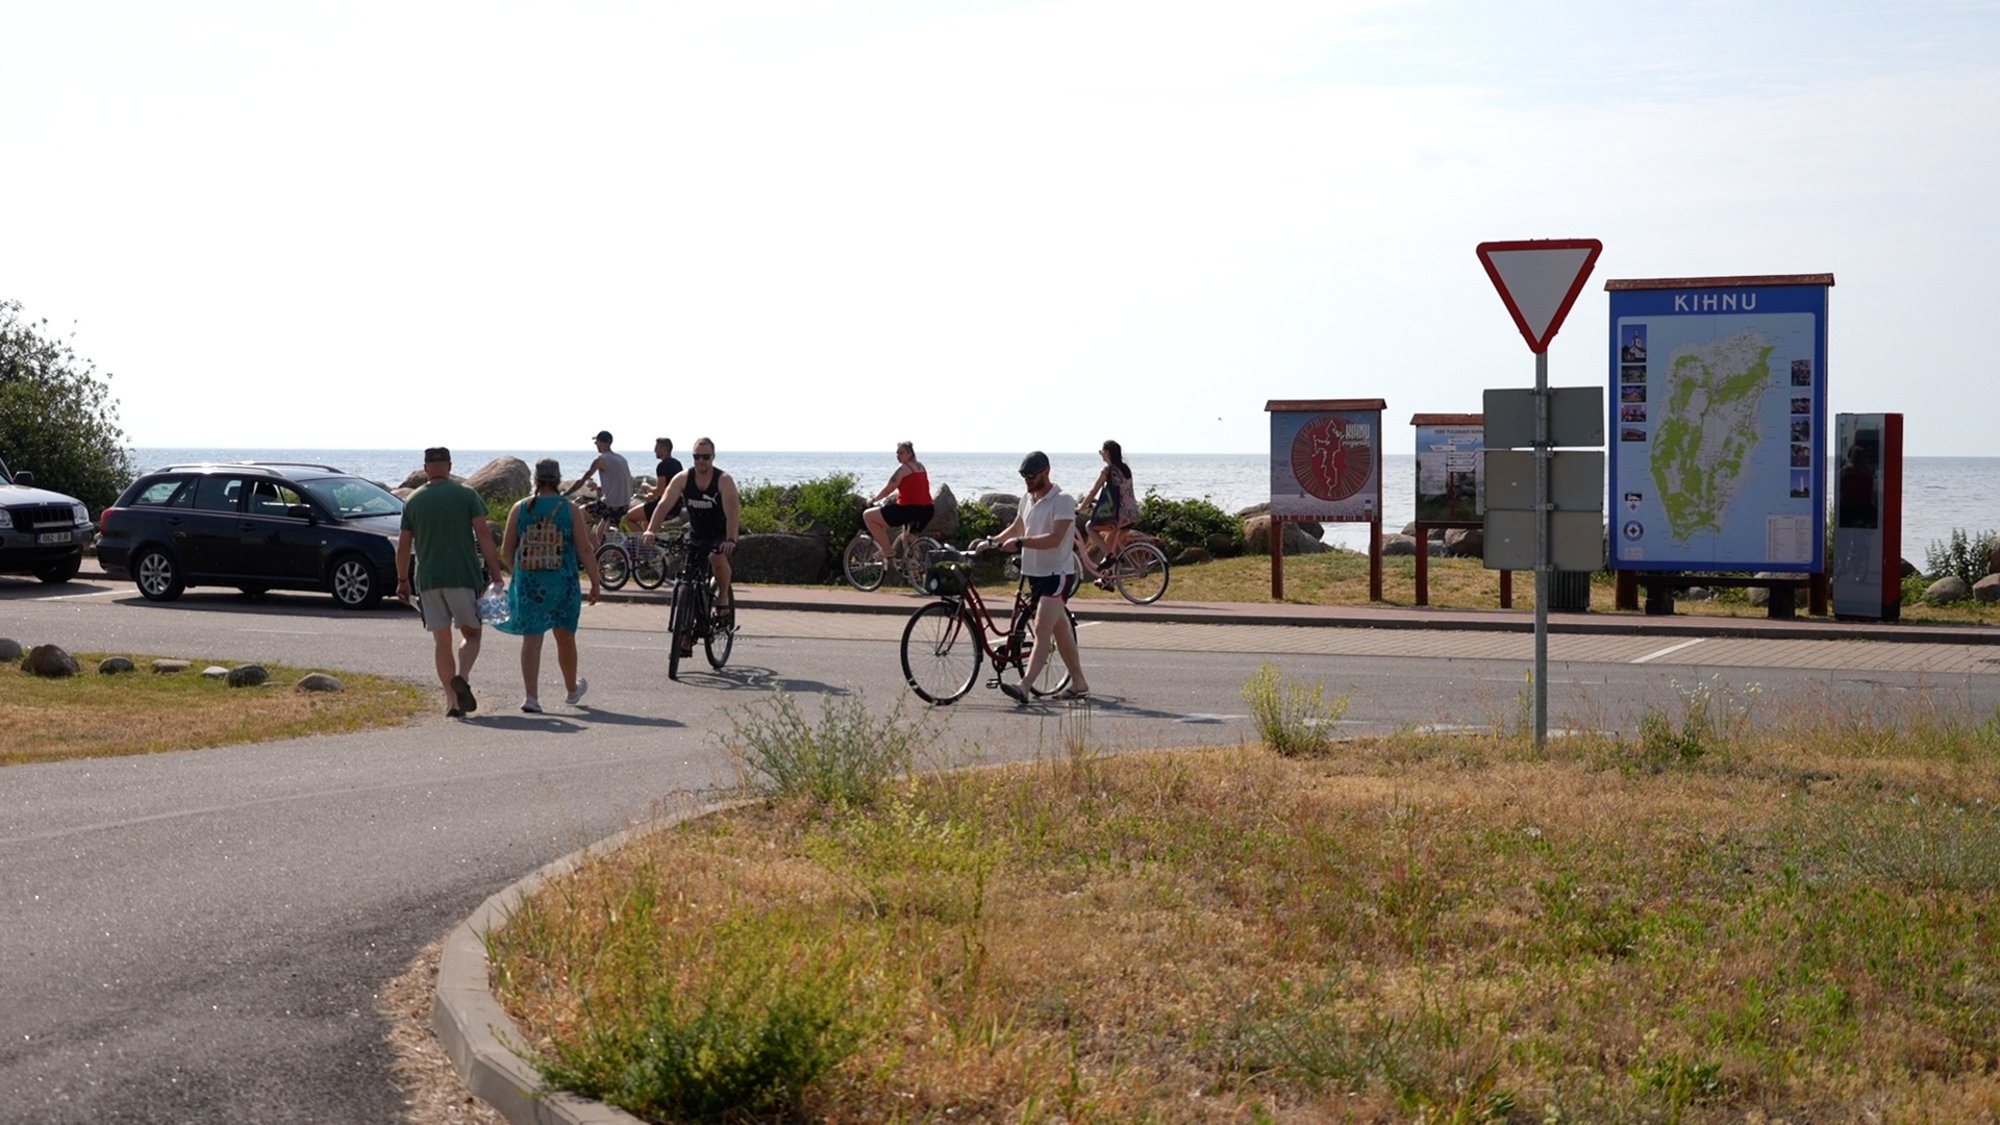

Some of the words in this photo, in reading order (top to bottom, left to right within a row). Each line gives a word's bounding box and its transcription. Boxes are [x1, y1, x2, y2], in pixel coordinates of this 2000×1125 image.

[1674, 293, 1756, 312] KIHNU
[1345, 423, 1370, 440] KIHNU
[687, 498, 713, 509] PUMA
